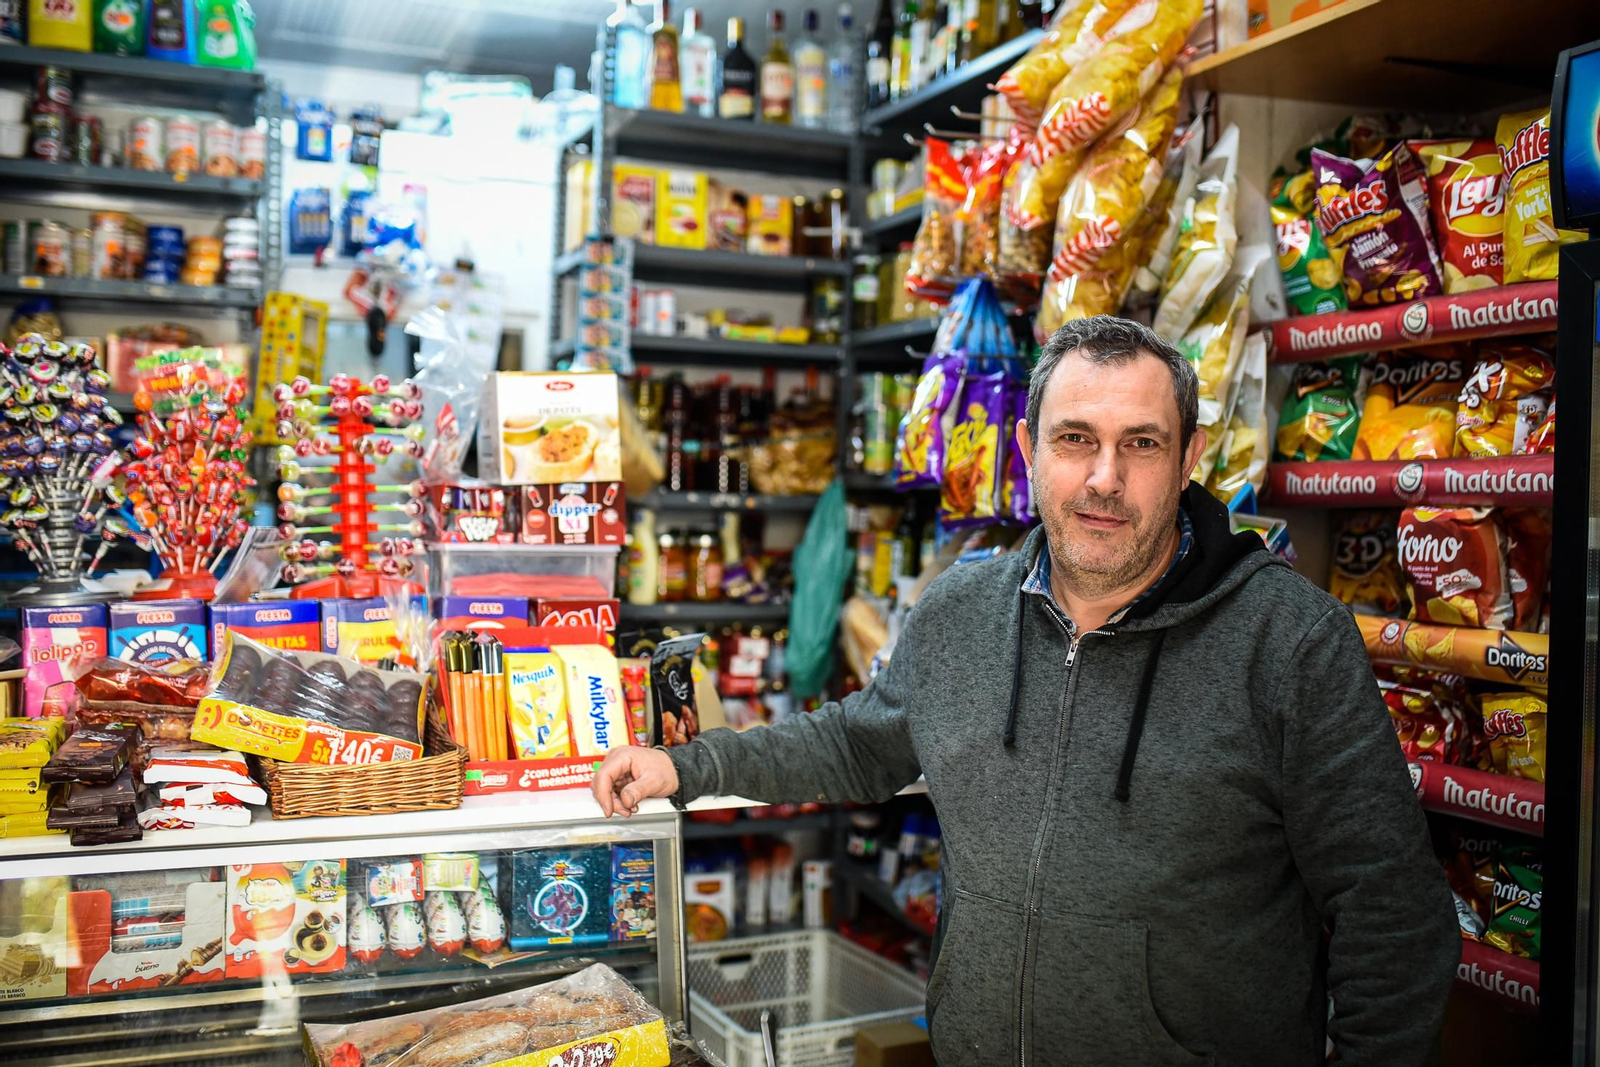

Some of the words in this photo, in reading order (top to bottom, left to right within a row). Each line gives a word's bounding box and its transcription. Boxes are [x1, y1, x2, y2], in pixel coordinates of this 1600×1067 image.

[1515, 195, 1549, 222] York'
[1463, 244, 1476, 258] Al
[1479, 242, 1504, 256] Pun
[1471, 255, 1486, 269] de
[1371, 360, 1463, 386] Doritos
[549, 501, 599, 516] dipper
[136, 611, 175, 624] FIESTA
[255, 609, 292, 622] FIESTA
[469, 602, 504, 615] FIESTA
[48, 613, 82, 623] FIESTA
[1488, 647, 1546, 671] Doritos
[512, 664, 556, 685] Nesquik
[587, 675, 611, 749] Milkybar
[1443, 776, 1545, 823] Matutan
[1493, 880, 1542, 910] oritos
[134, 962, 160, 974] bueno
[1455, 963, 1540, 1006] atutan
